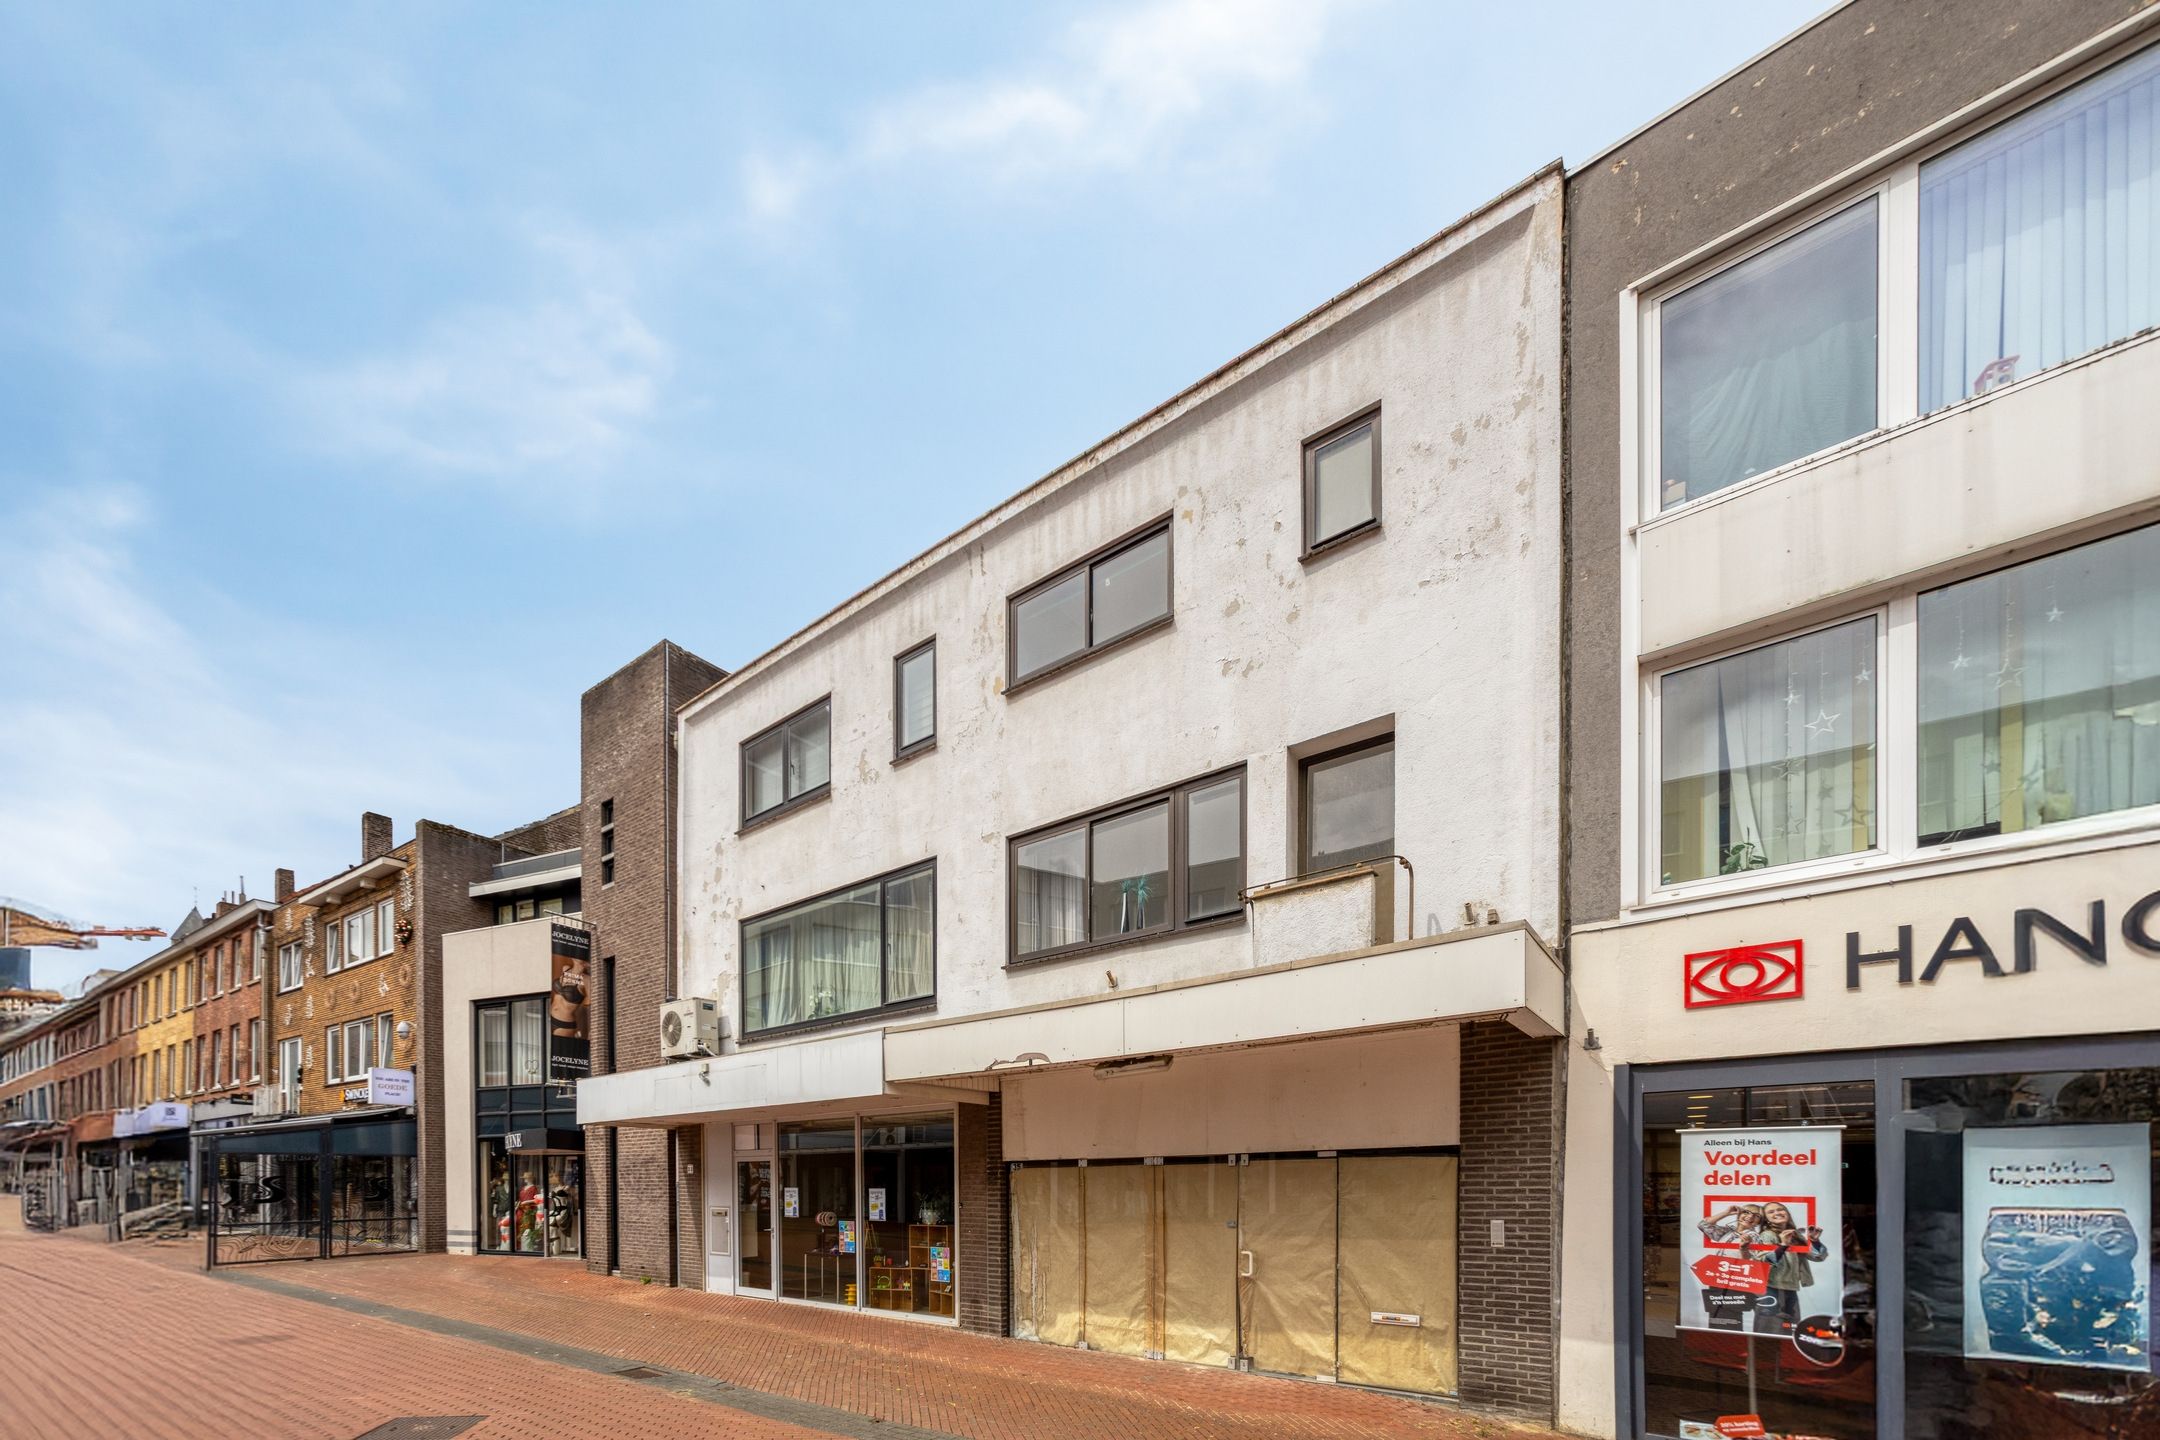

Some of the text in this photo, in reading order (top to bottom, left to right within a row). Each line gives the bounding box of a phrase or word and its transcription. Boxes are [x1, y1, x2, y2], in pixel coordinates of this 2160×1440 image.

[552, 931, 589, 945] JOCELYNE
[552, 1055, 589, 1066] JOCELYNE
[1734, 1139, 1746, 1147] bij
[1704, 1149, 1816, 1166] Voordeel
[1703, 1170, 1771, 1186] delen
[1716, 1278, 1750, 1289] bril gratis
[1731, 1274, 1764, 1285] complete
